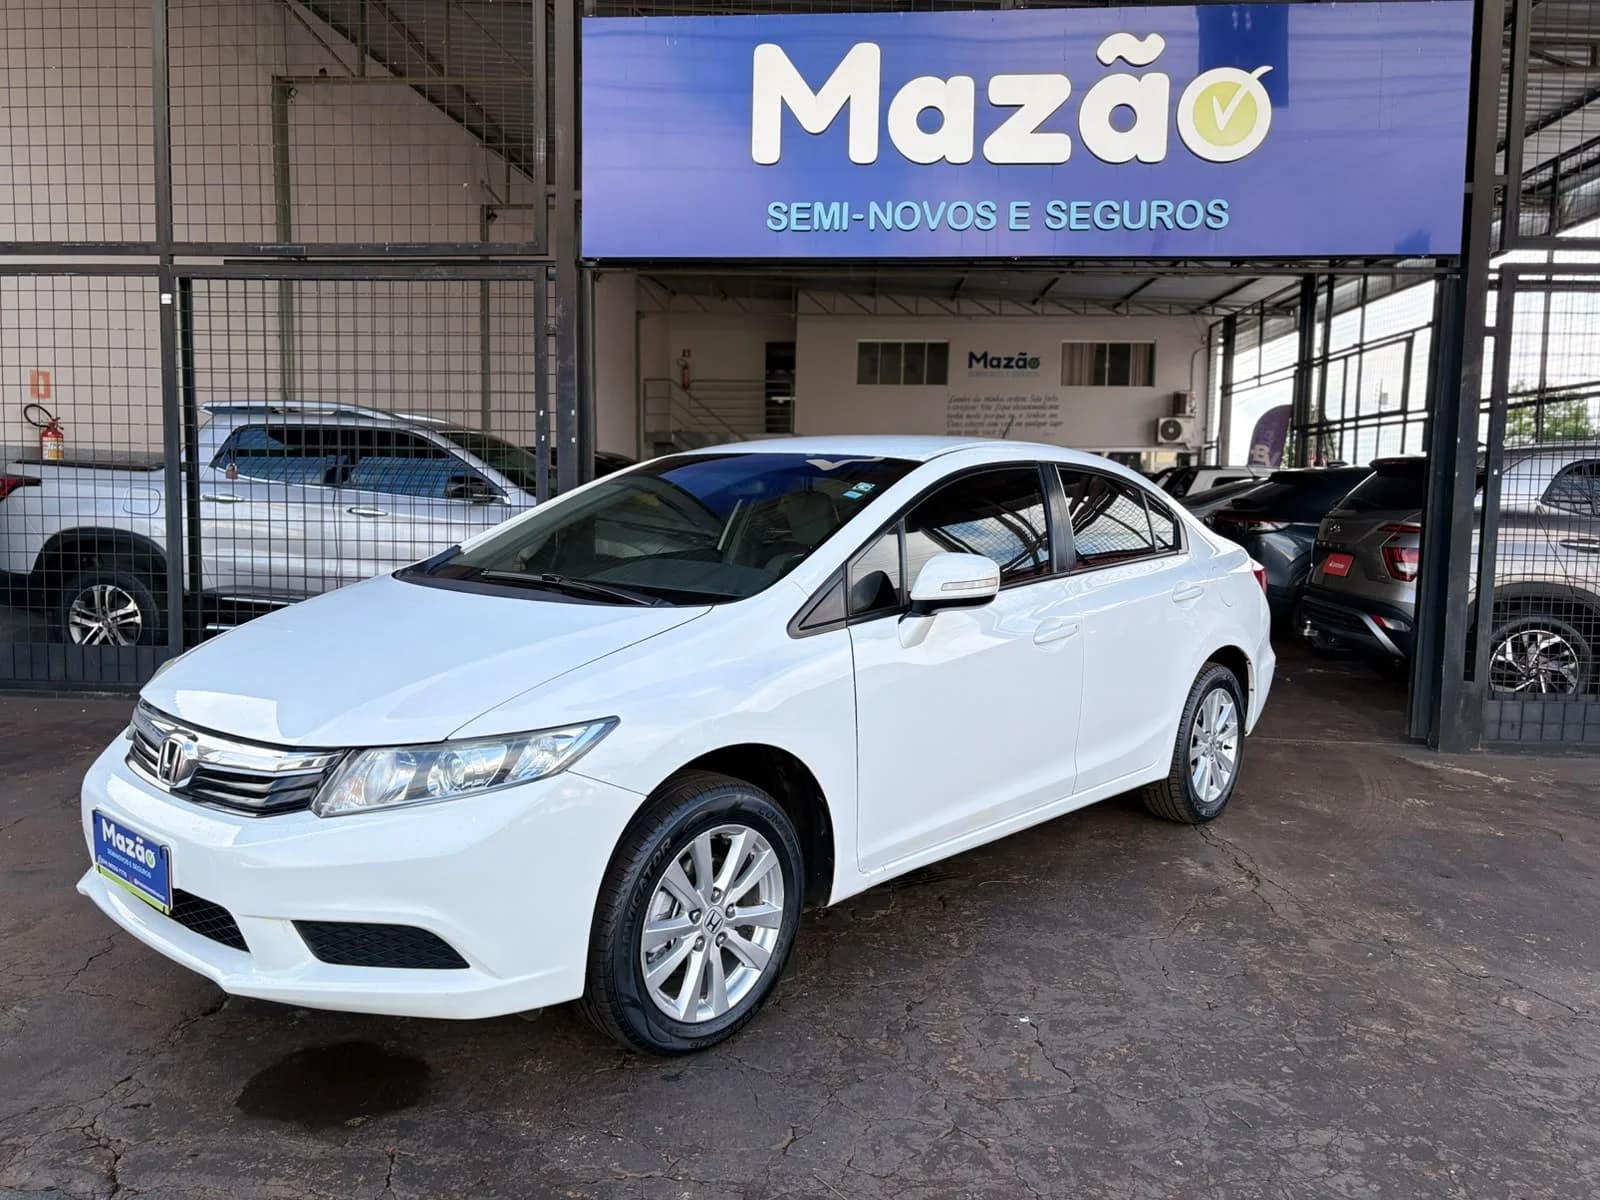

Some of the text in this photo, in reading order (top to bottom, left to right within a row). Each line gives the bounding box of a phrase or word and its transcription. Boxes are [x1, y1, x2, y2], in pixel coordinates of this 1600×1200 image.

[752, 32, 1273, 165] Mazão
[766, 199, 1230, 231] SEMI-NOVOS E SEGUROS
[968, 351, 1040, 369] Mazão
[101, 817, 156, 869] Mazão
